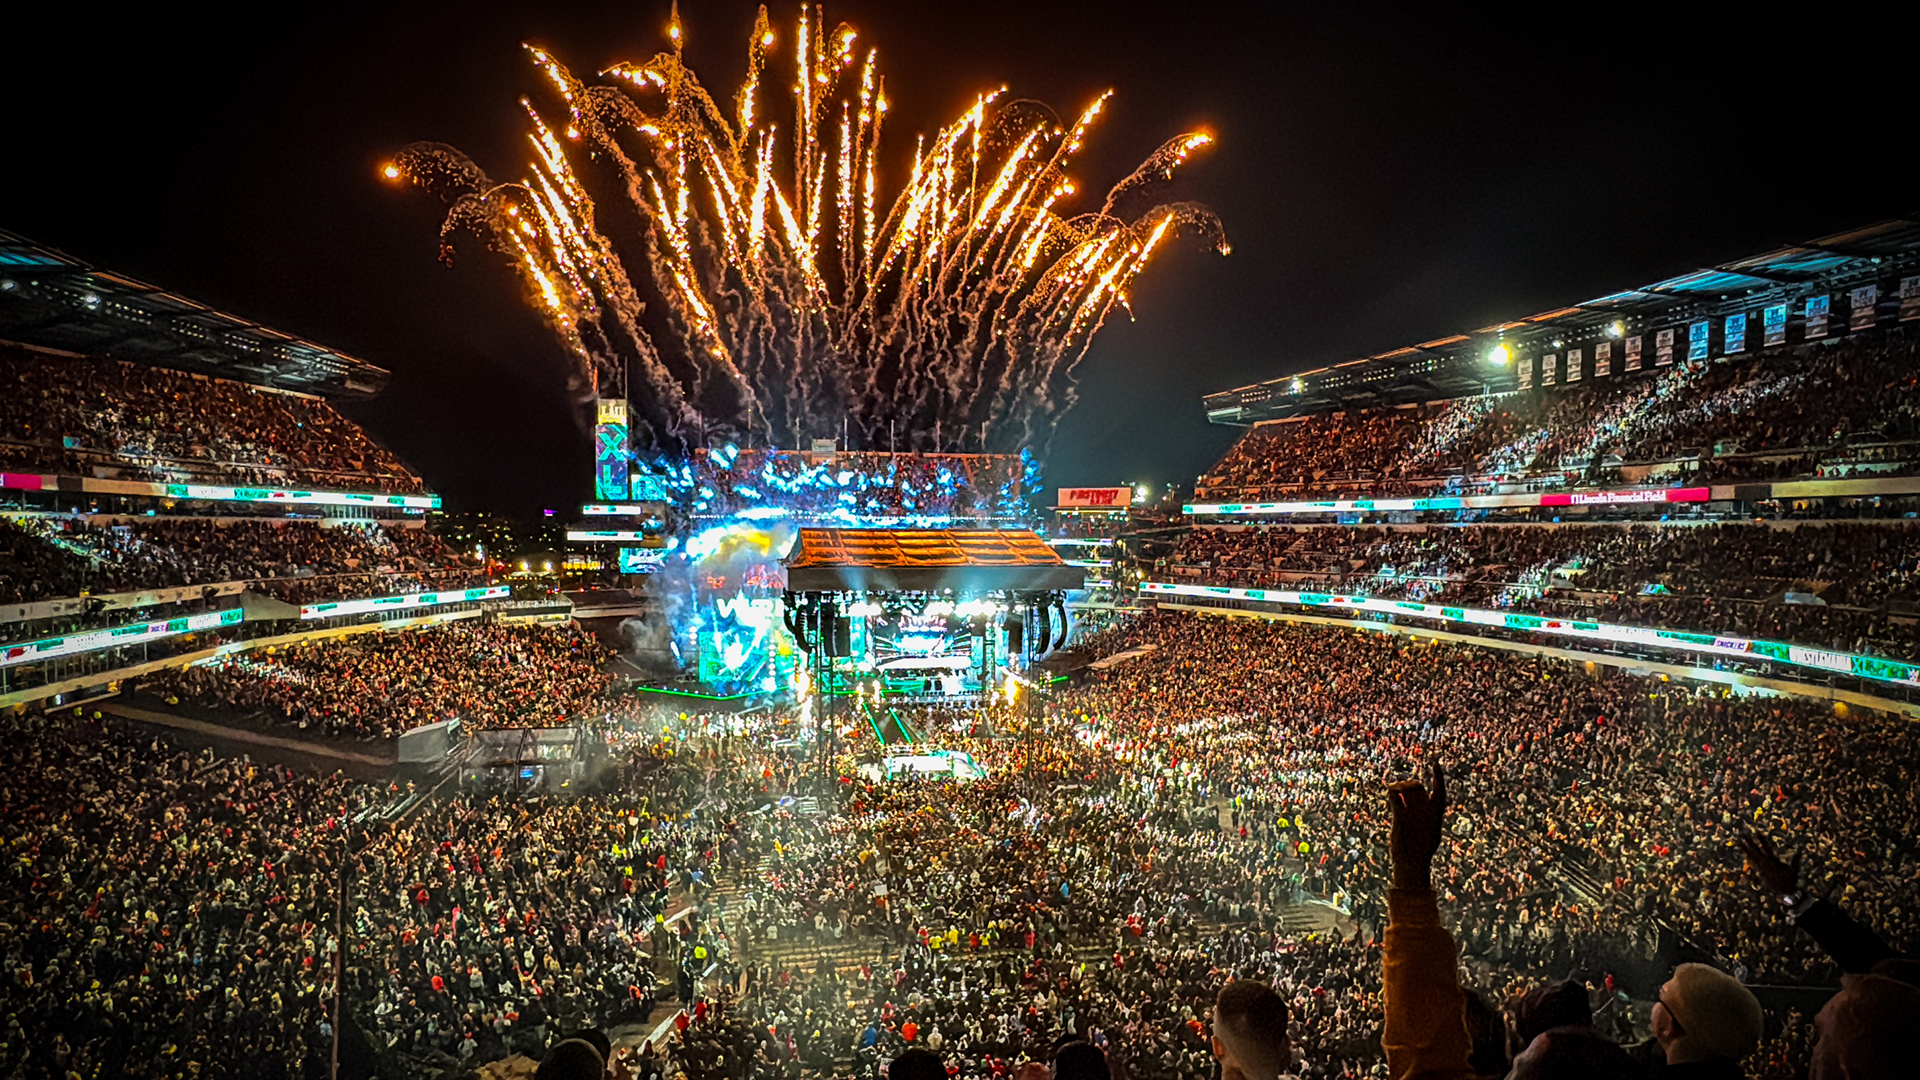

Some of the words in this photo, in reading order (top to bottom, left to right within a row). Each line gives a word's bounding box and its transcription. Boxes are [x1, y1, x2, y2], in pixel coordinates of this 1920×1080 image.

[1580, 494, 1607, 504] Lincoln
[1608, 492, 1643, 502] Financial
[1644, 490, 1666, 501] Field
